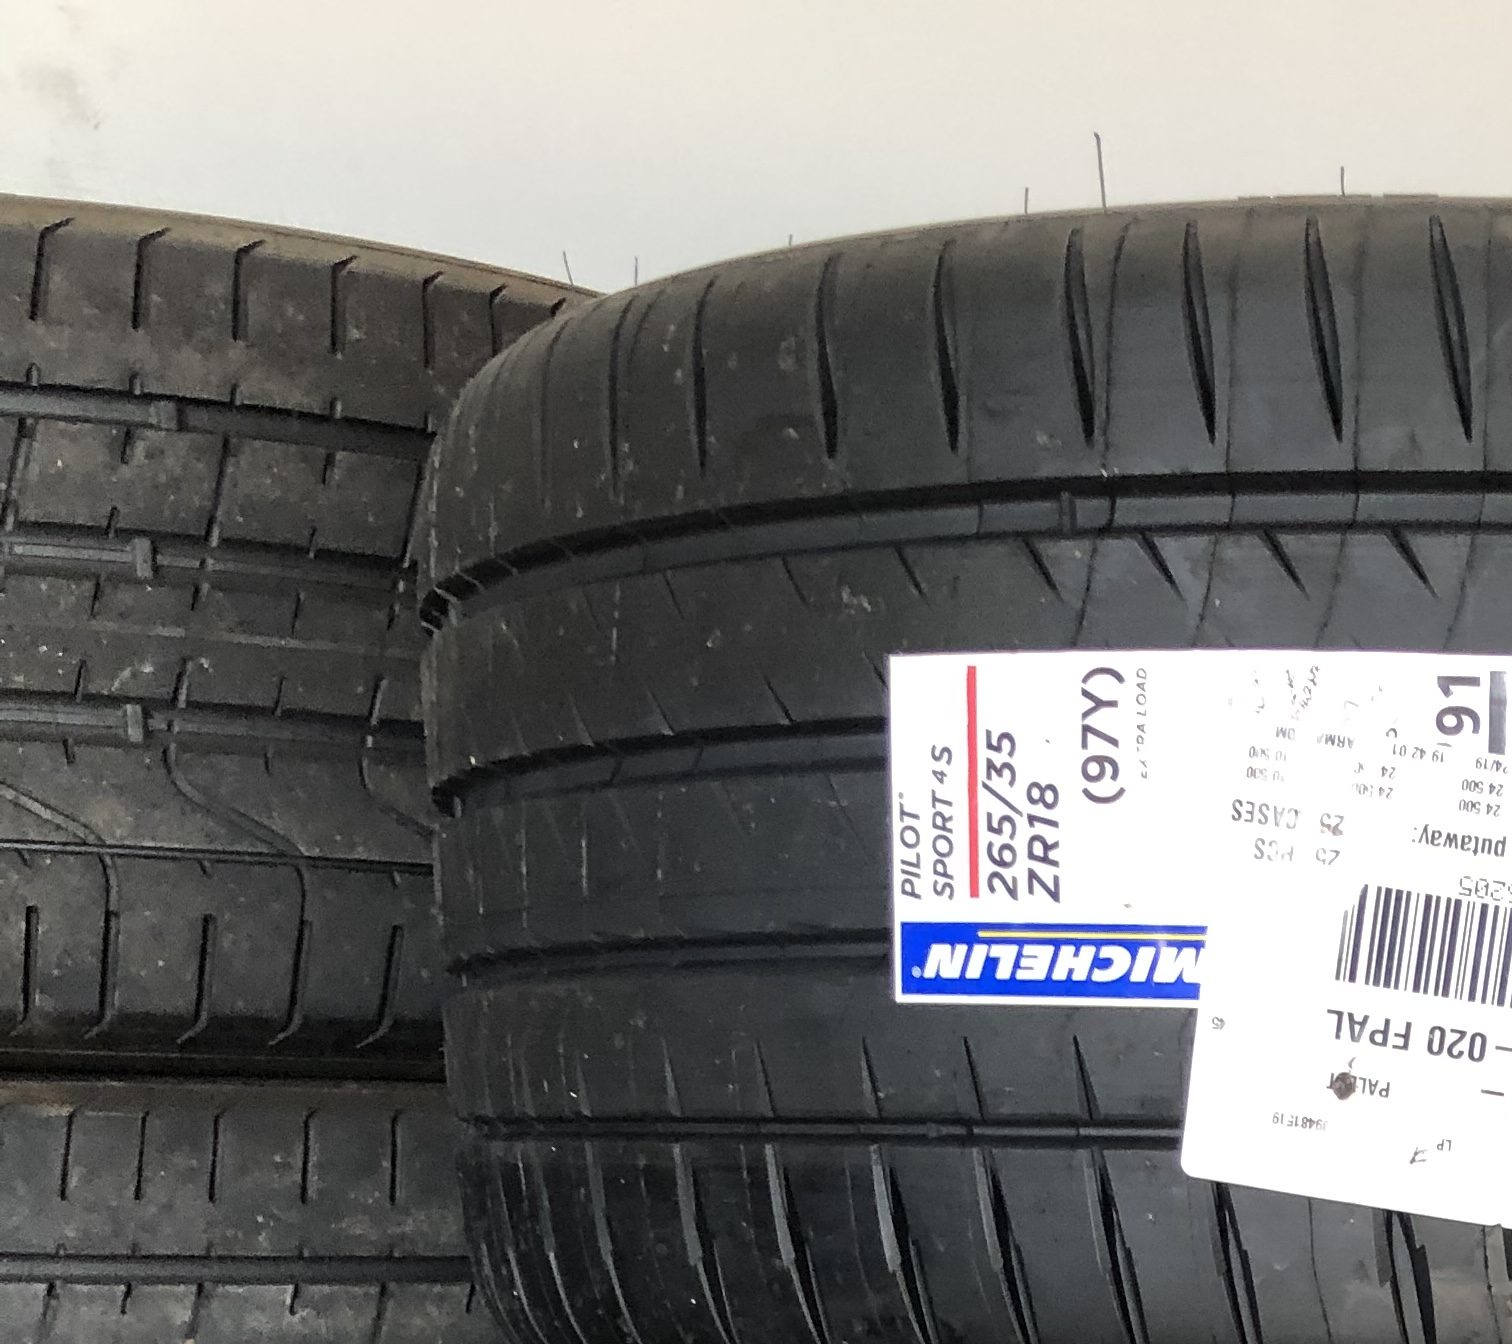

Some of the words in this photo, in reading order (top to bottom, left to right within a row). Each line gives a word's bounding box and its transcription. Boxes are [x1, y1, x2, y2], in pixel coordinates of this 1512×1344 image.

[1135, 667, 1147, 717] LOAD
[1080, 665, 1126, 804] (97Y)
[982, 730, 1022, 902] 265/35
[1230, 799, 1300, 829] CASES
[900, 805, 921, 900] PILOT
[932, 785, 954, 900] SPORT
[1027, 781, 1061, 904] ZR18
[1411, 824, 1507, 859] putaway:
[923, 944, 1200, 986] MICHELIN
[1326, 1009, 1412, 1051] FPAL
[1436, 1139, 1452, 1152] LP
